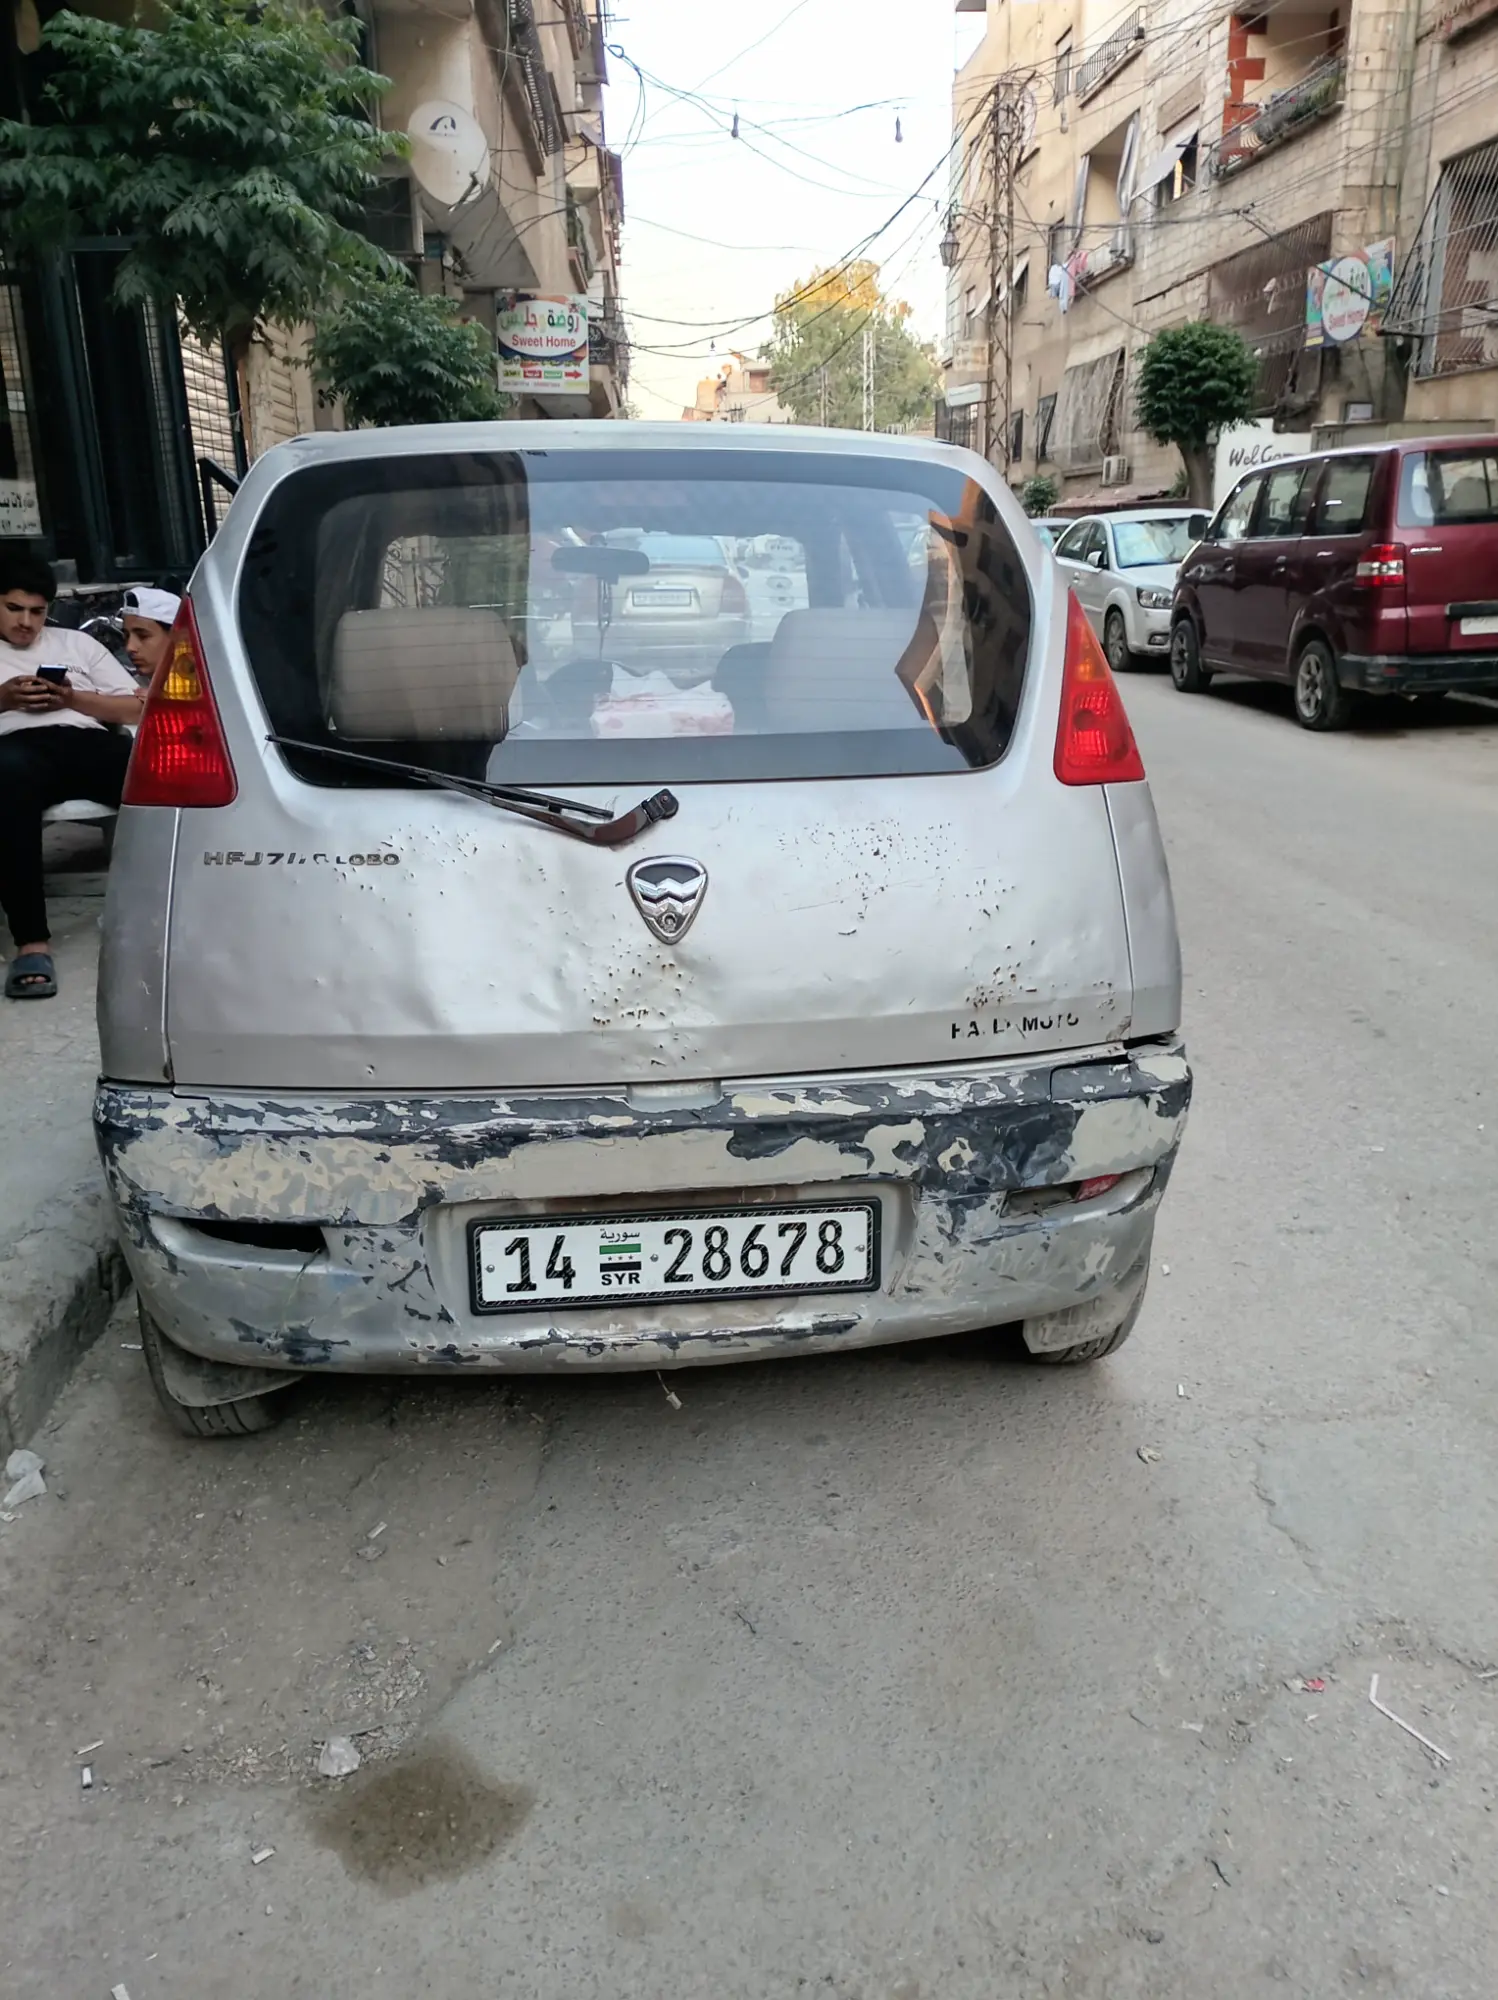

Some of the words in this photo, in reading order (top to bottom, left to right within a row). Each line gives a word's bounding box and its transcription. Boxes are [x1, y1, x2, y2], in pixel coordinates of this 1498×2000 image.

[547, 308, 580, 333] روضة
[511, 334, 543, 347] Sweet
[546, 336, 576, 347] Home
[600, 1228, 641, 1243] سورية
[504, 1234, 577, 1293] 14
[662, 1219, 845, 1284] 28678
[601, 1272, 641, 1286] SYR
